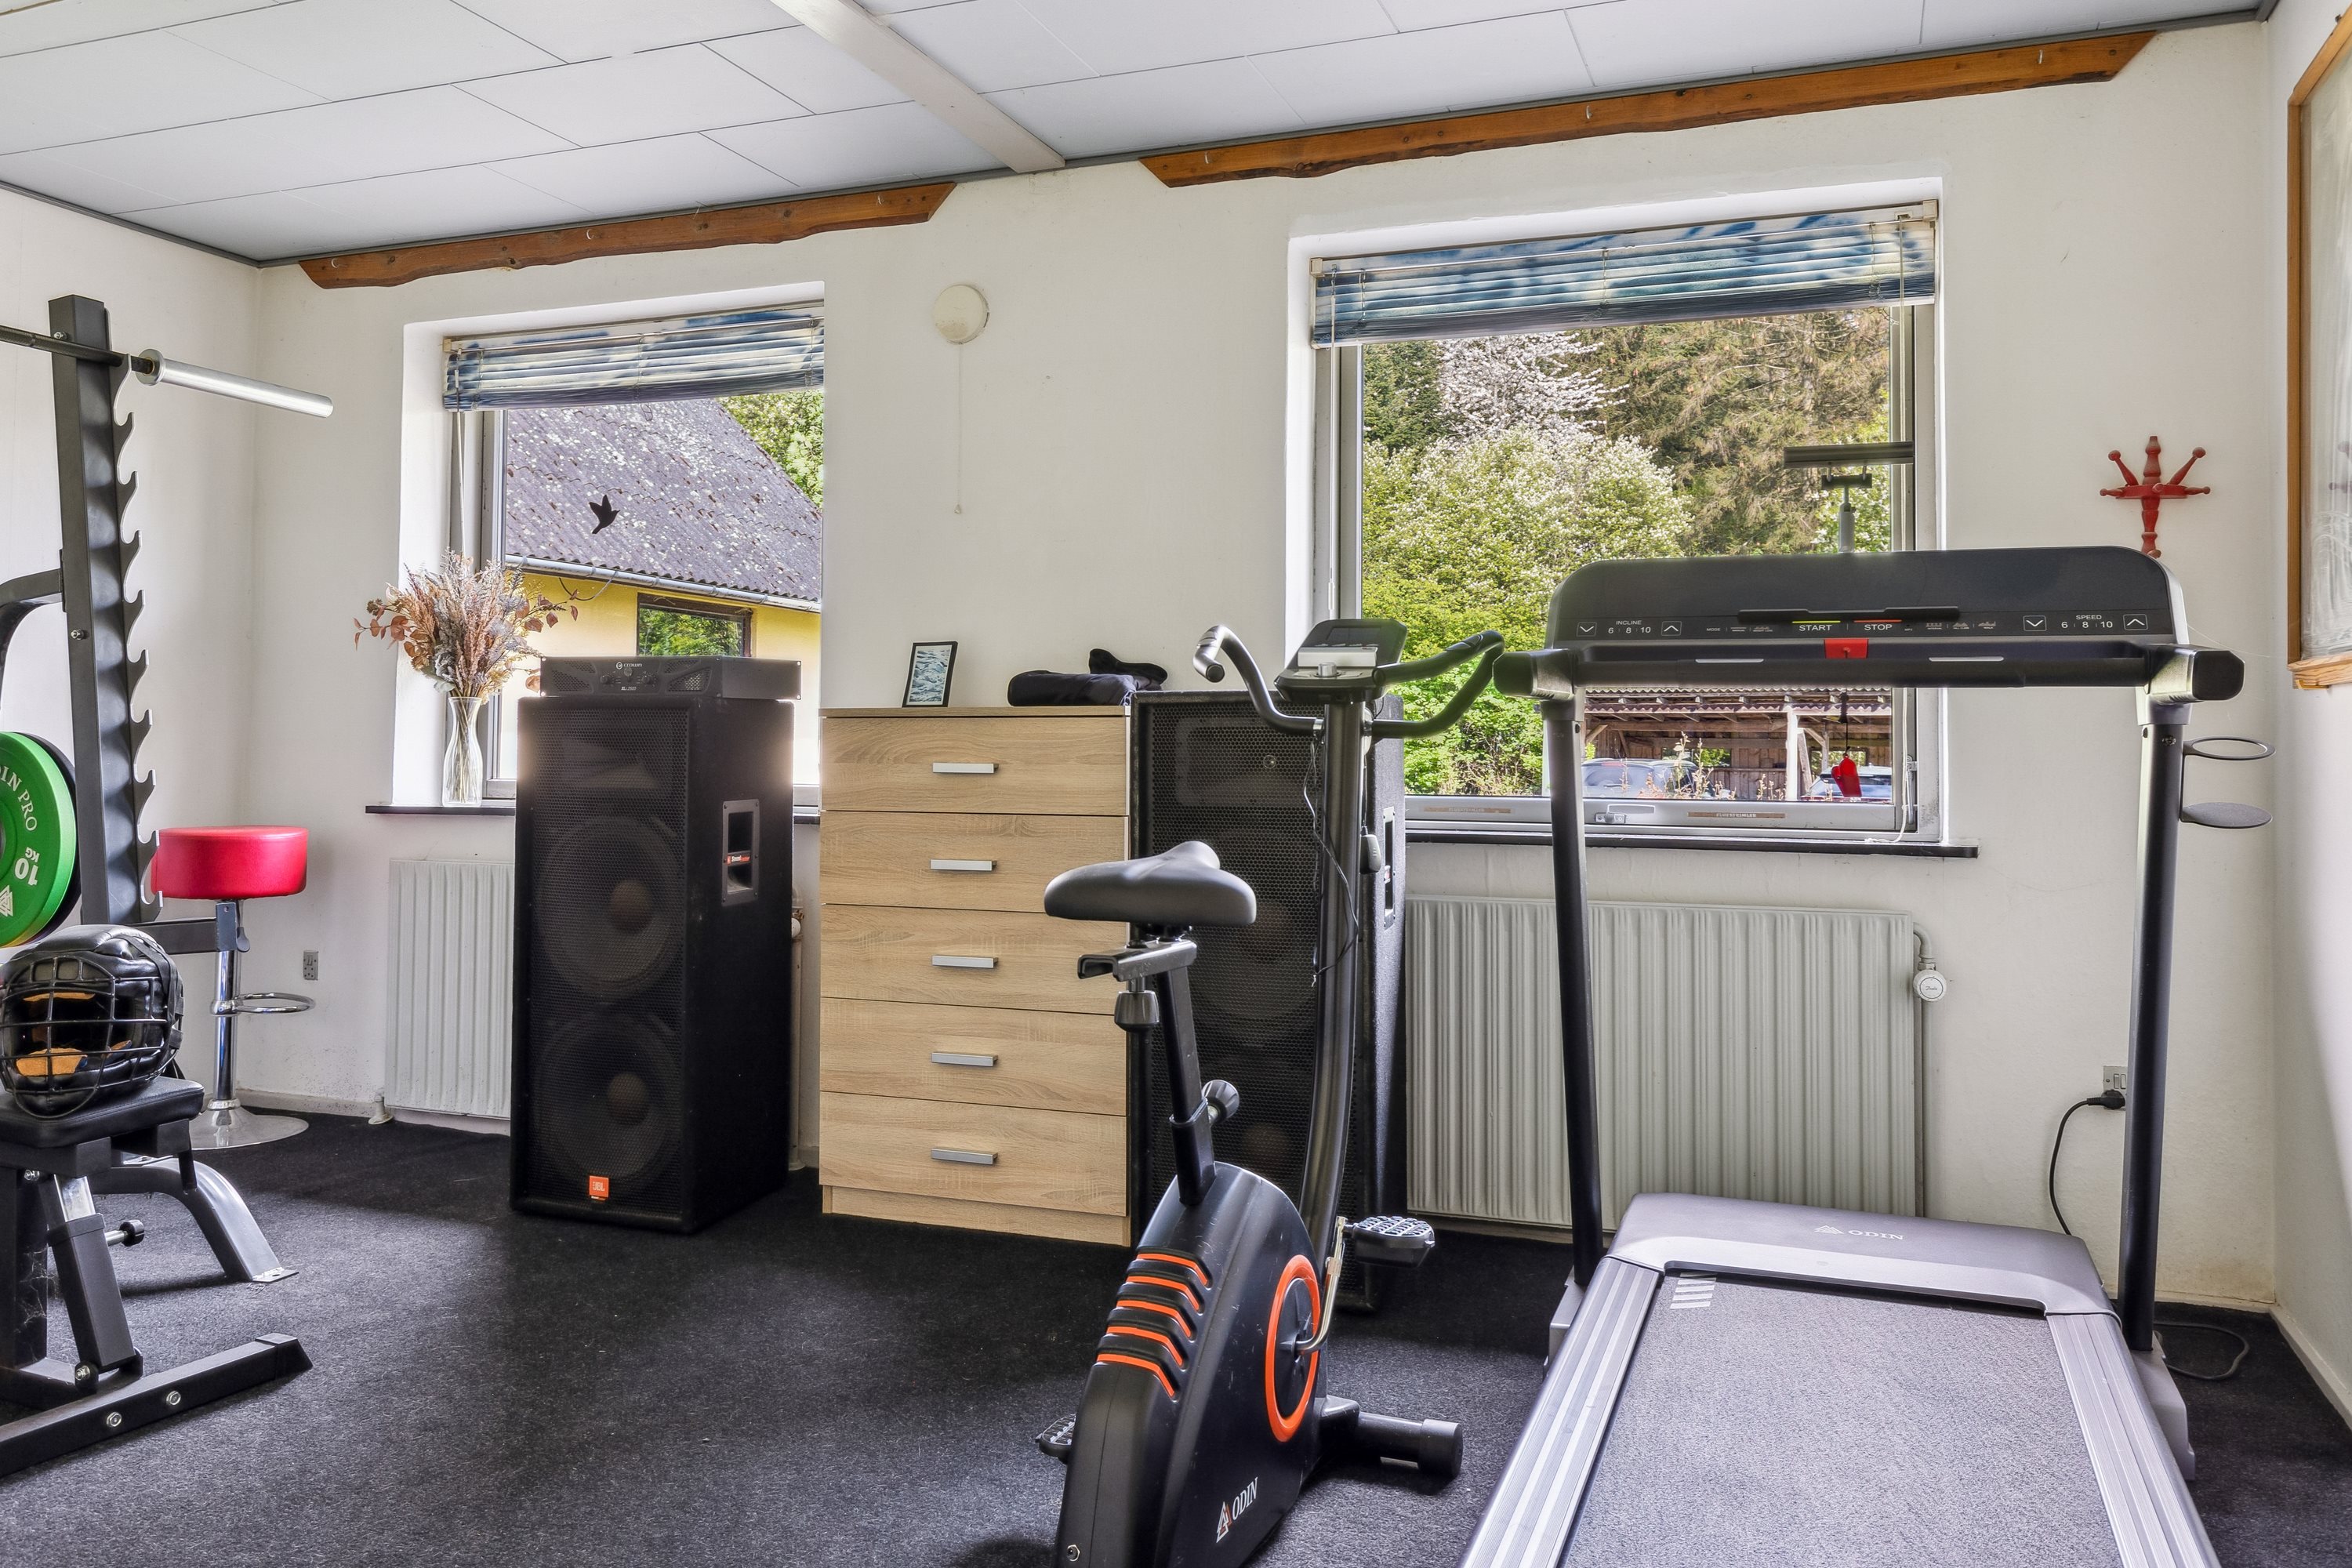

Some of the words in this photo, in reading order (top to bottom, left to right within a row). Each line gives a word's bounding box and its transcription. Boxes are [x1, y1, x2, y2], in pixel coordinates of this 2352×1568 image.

[0, 764, 22, 792] IN
[17, 789, 38, 832] PRO
[25, 847, 40, 862] KG
[14, 858, 38, 886] 10
[593, 1181, 605, 1192] JBL
[1848, 1229, 1905, 1240] ODIN
[1232, 1476, 1258, 1520] ODIN
